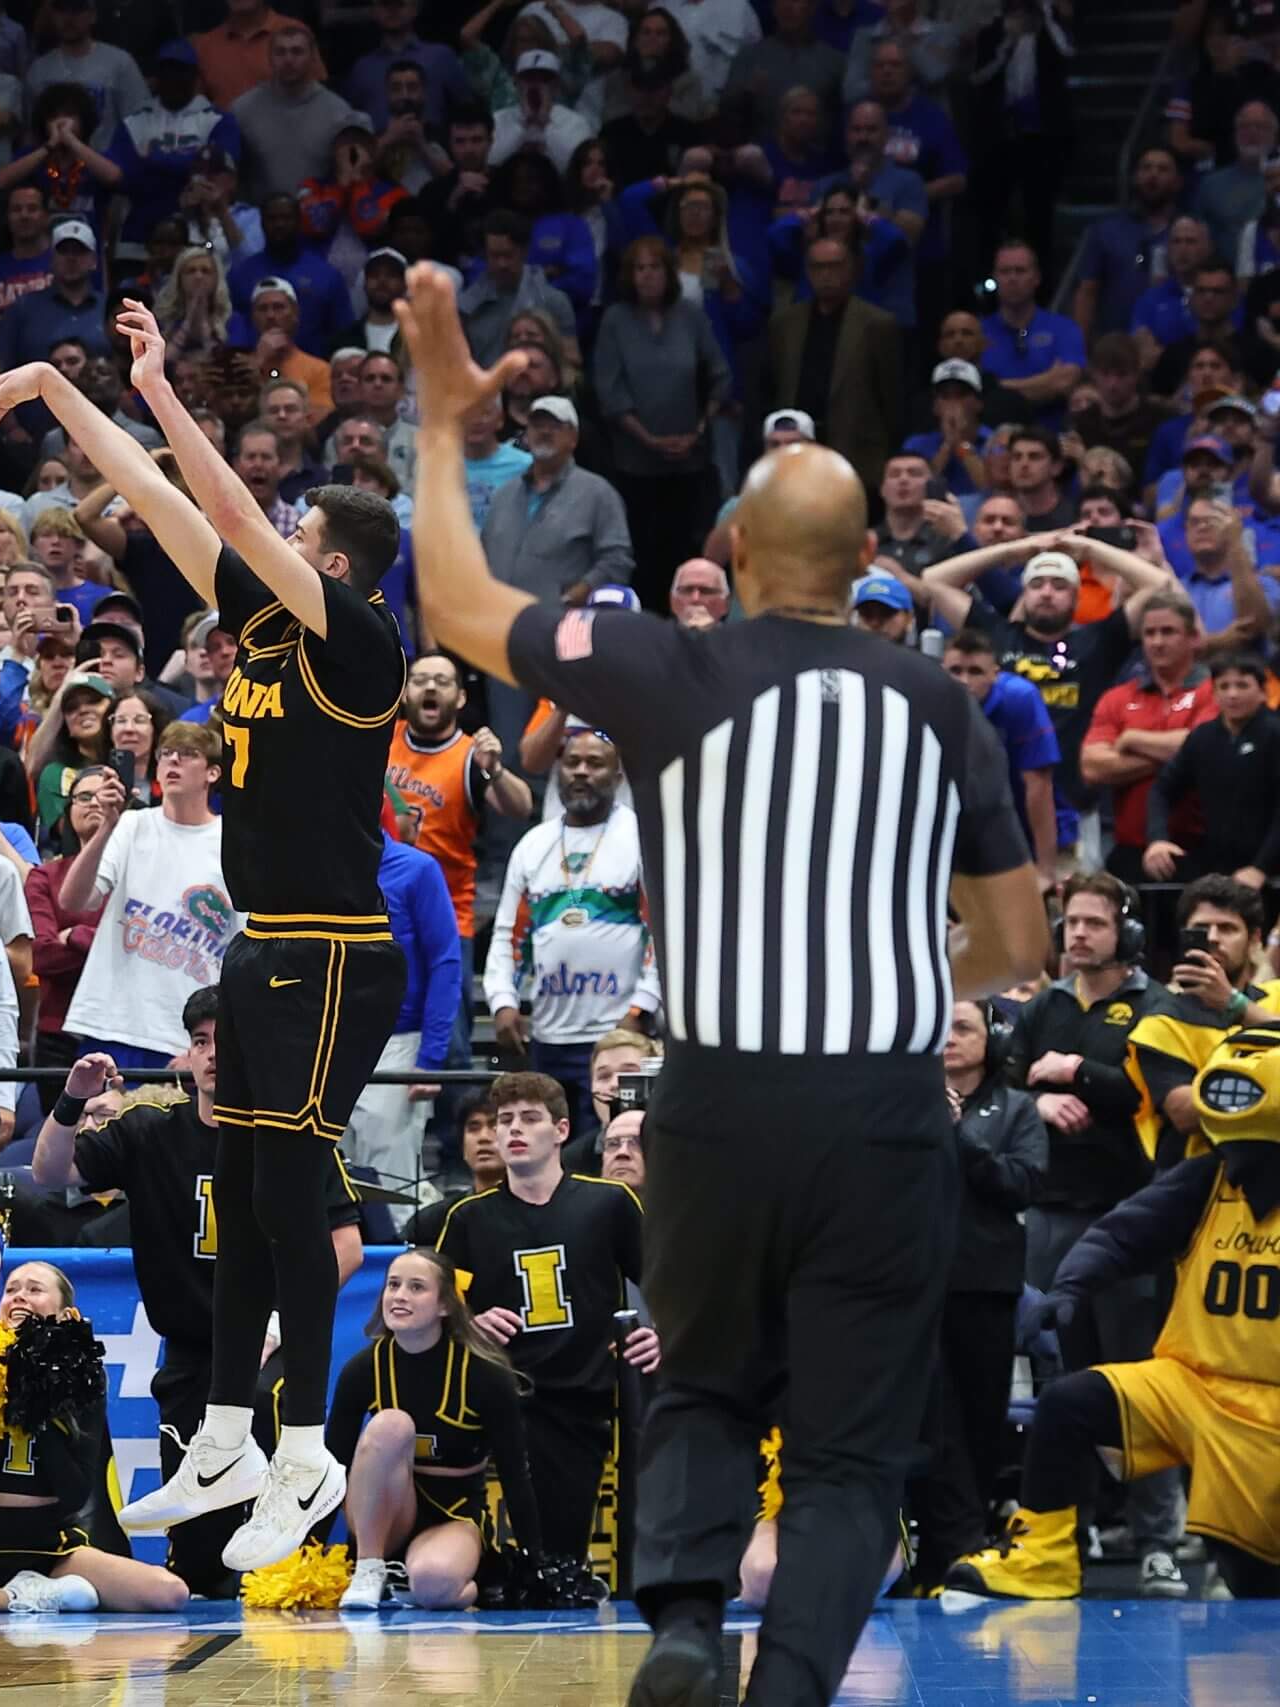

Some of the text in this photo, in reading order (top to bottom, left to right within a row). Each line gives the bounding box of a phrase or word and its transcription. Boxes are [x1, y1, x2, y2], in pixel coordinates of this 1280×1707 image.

[223, 666, 284, 718] OWA
[223, 720, 249, 789] 7
[513, 1244, 574, 1333] I
[1204, 1260, 1280, 1322] 00
